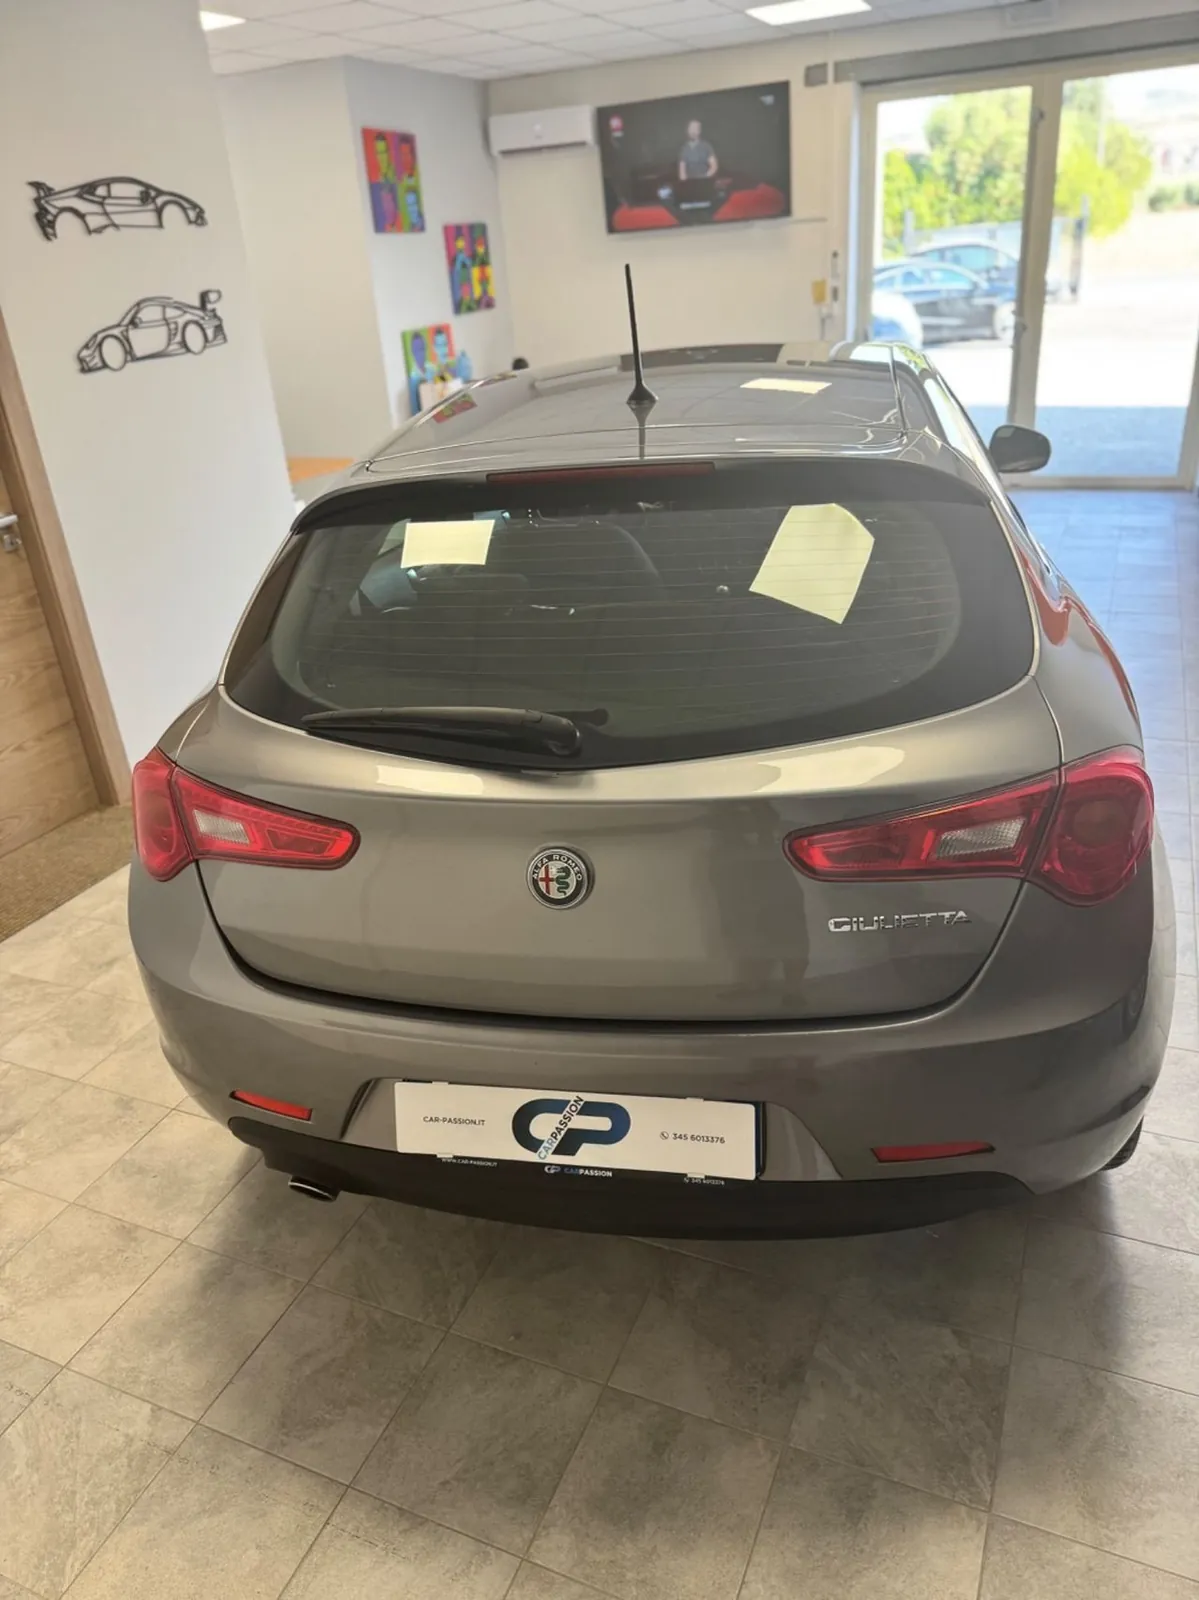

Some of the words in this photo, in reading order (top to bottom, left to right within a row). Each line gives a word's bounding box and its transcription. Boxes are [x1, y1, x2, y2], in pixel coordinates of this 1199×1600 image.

[533, 857, 549, 879] ALFA
[552, 854, 583, 881] ROMEO
[828, 910, 972, 932] GIULIETTA
[422, 1116, 486, 1126] CAR-PASSION.IT
[537, 1095, 584, 1160] CARPASSION
[672, 1132, 689, 1141] 345
[690, 1134, 726, 1144] 6013376
